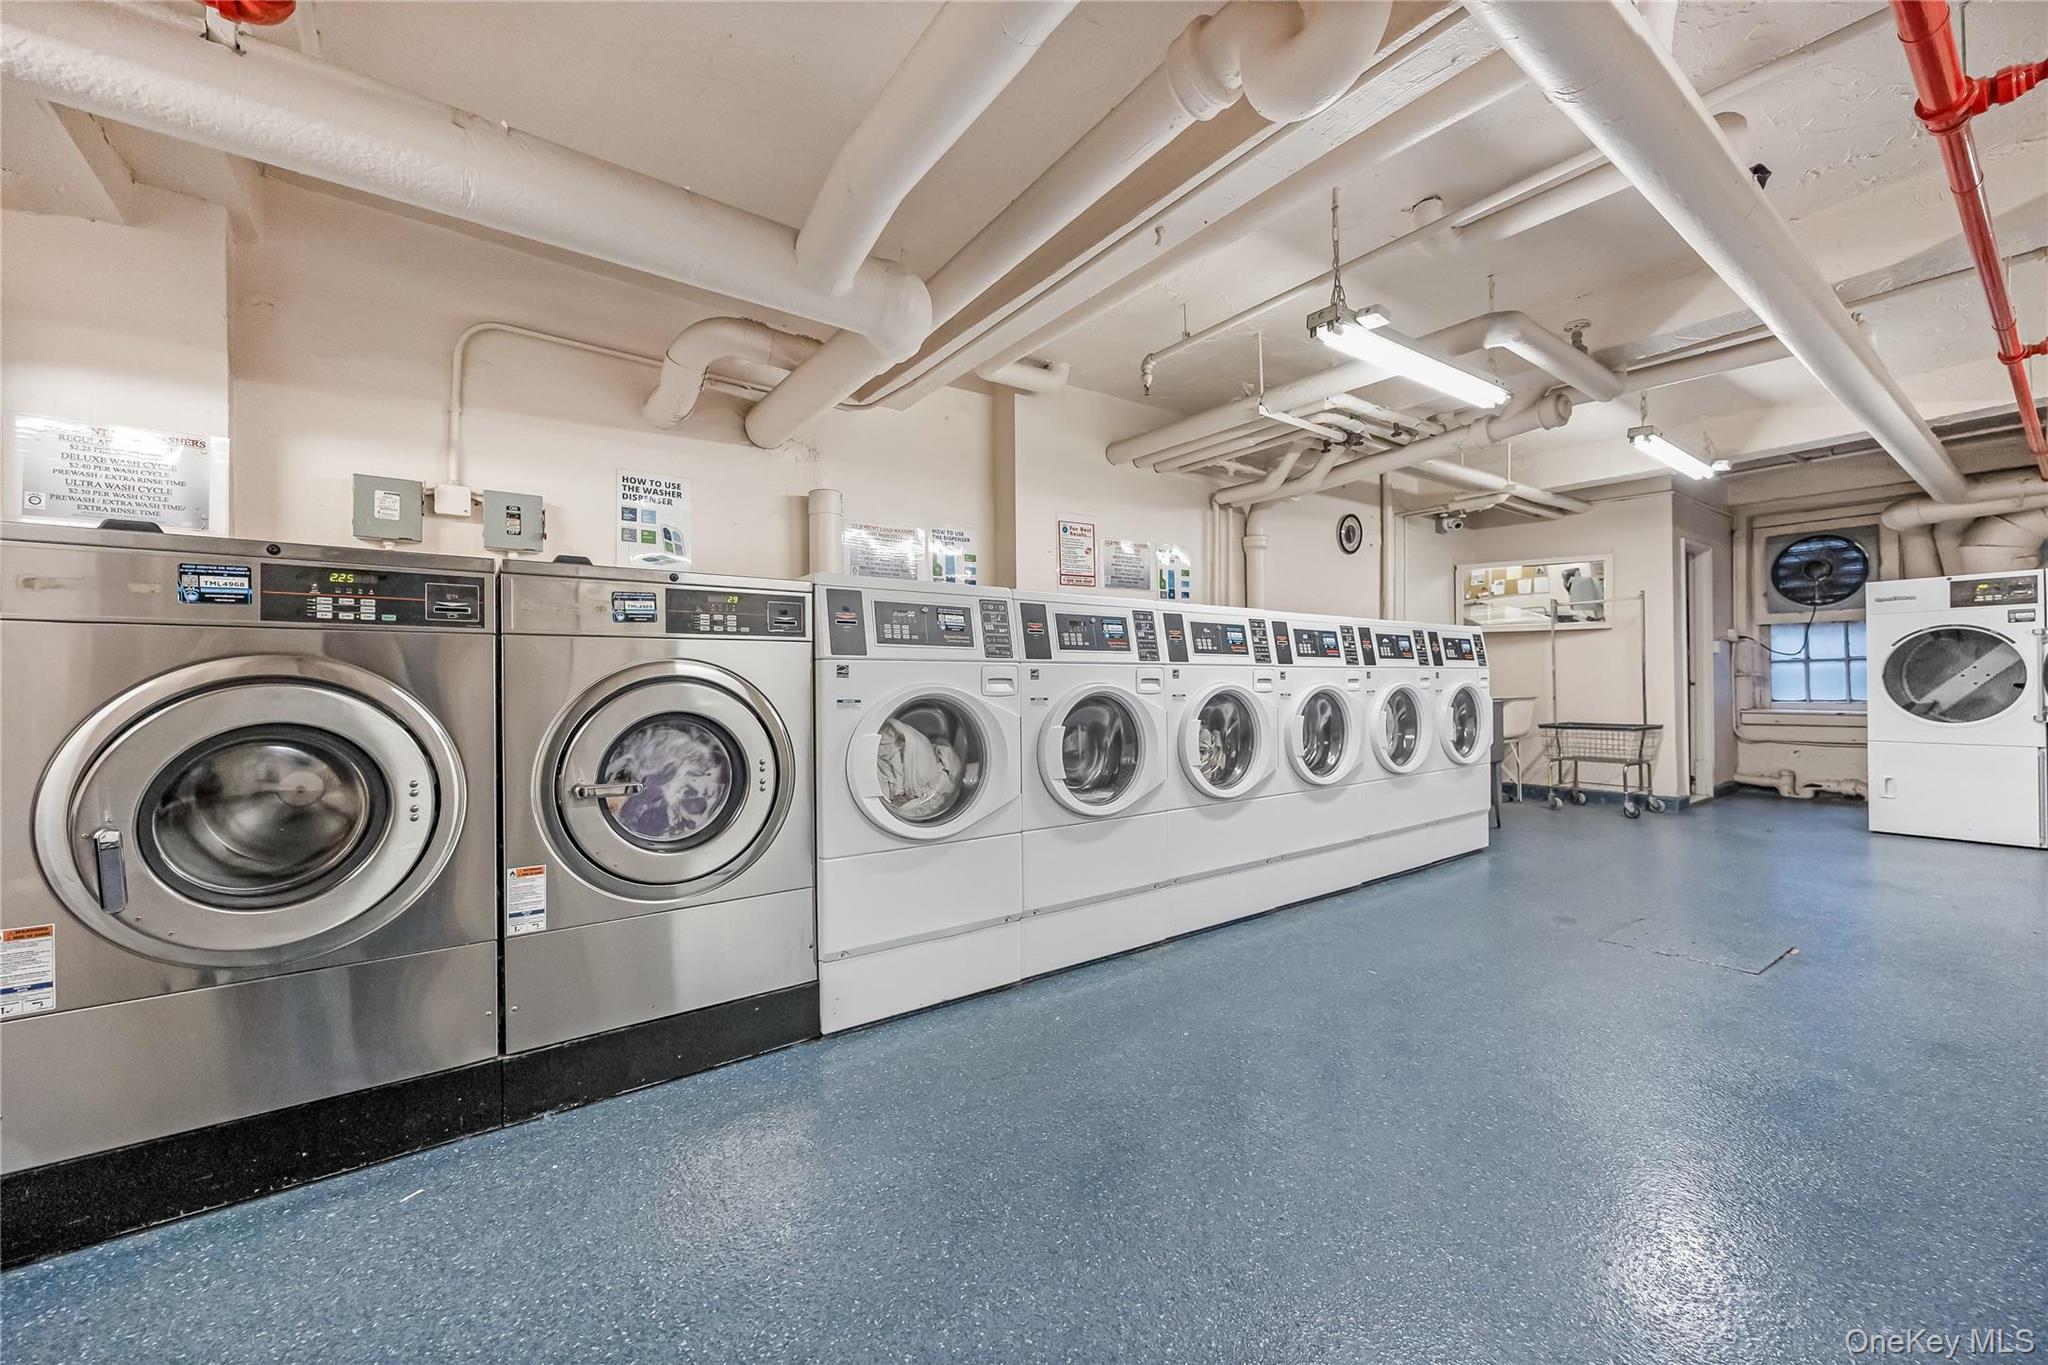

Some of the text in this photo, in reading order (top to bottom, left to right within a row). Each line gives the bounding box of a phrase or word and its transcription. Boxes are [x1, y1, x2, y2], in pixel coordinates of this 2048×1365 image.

[61, 452, 107, 464] DELUXE
[109, 457, 140, 469] WASH
[52, 468, 98, 478] PREWASH
[105, 474, 136, 482] EXTRA
[137, 477, 164, 485] RINSE
[69, 461, 92, 470] $2.40
[113, 467, 138, 476] WASH
[140, 470, 170, 478] CYCLE
[65, 478, 173, 495] ULTRA WASH CYCLE
[622, 476, 681, 490] HOW TO USE
[68, 487, 91, 495] $2.50
[112, 492, 138, 500] WASH
[622, 484, 682, 499] THE WASHER
[49, 493, 95, 503] PREWASH
[102, 498, 133, 507] EXTRA
[134, 501, 160, 509] WASH
[622, 493, 673, 506] DISPENSER
[77, 504, 108, 512] EXTRA
[110, 507, 138, 515] RINSE
[140, 509, 161, 517] TIME
[329, 573, 354, 583] 2.25
